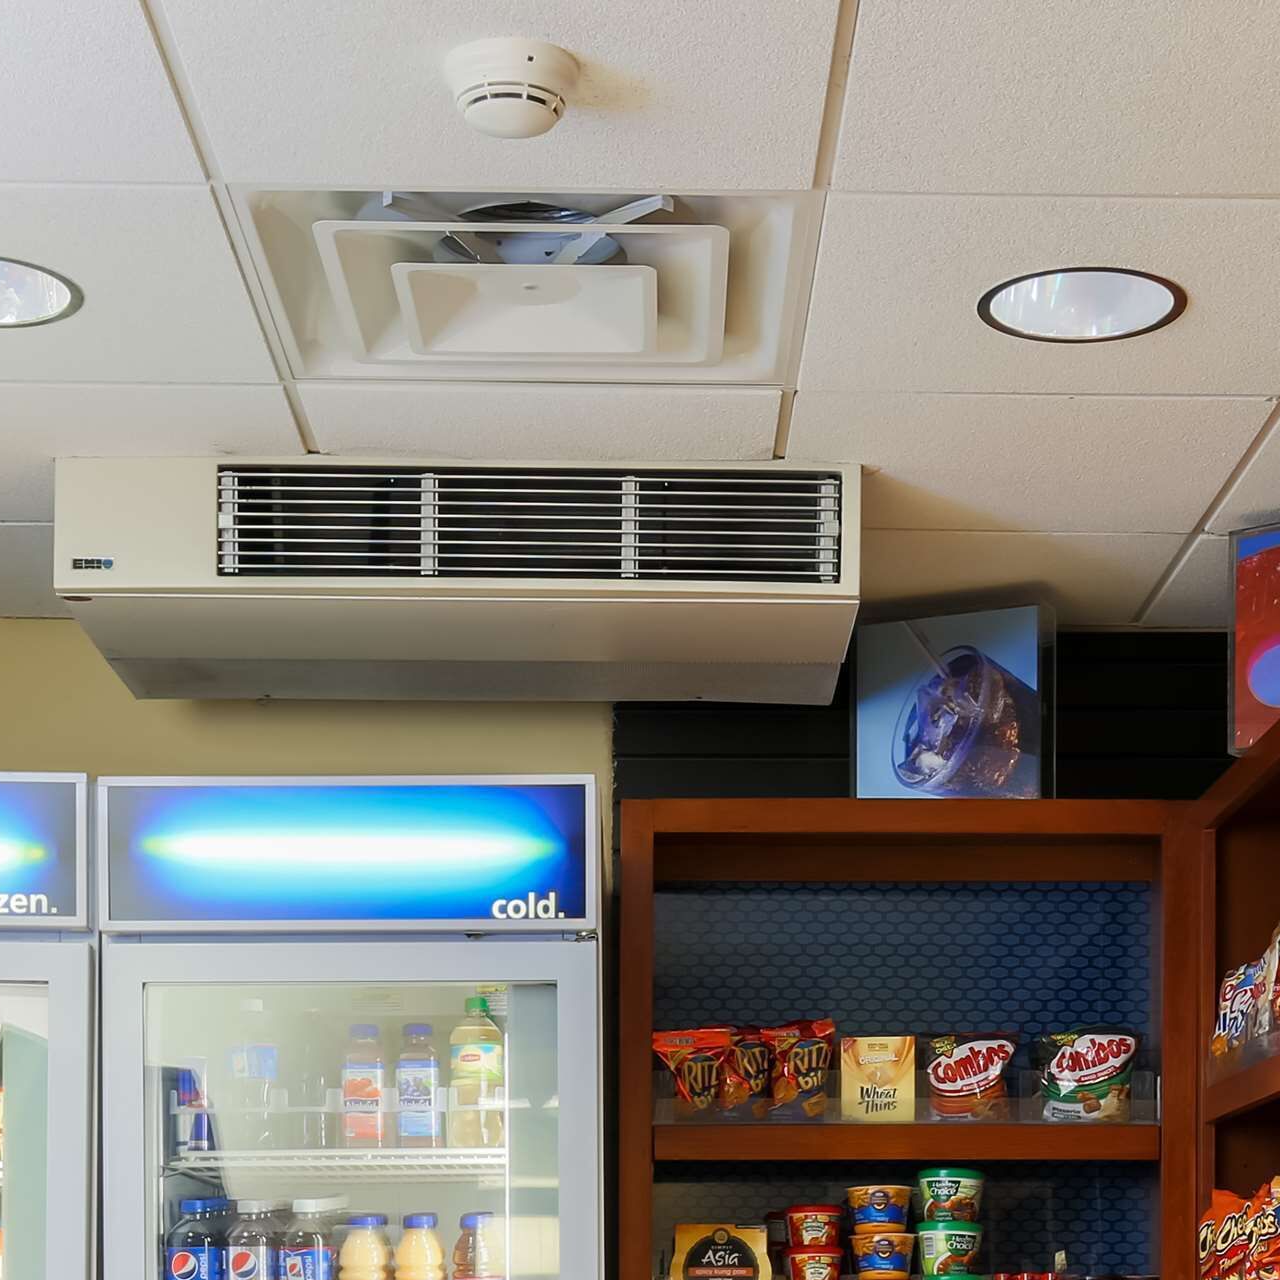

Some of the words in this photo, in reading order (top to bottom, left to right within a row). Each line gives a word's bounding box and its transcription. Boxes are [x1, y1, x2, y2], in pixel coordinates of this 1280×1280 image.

[492, 892, 565, 920] cold.
[790, 1043, 828, 1074] RITZ
[931, 1044, 1010, 1084] Combos
[1055, 1038, 1131, 1073] Combos
[860, 1086, 898, 1100] Wheat
[858, 1100, 898, 1114] Thins
[929, 1187, 956, 1196] Choice
[701, 1249, 739, 1267] Asia
